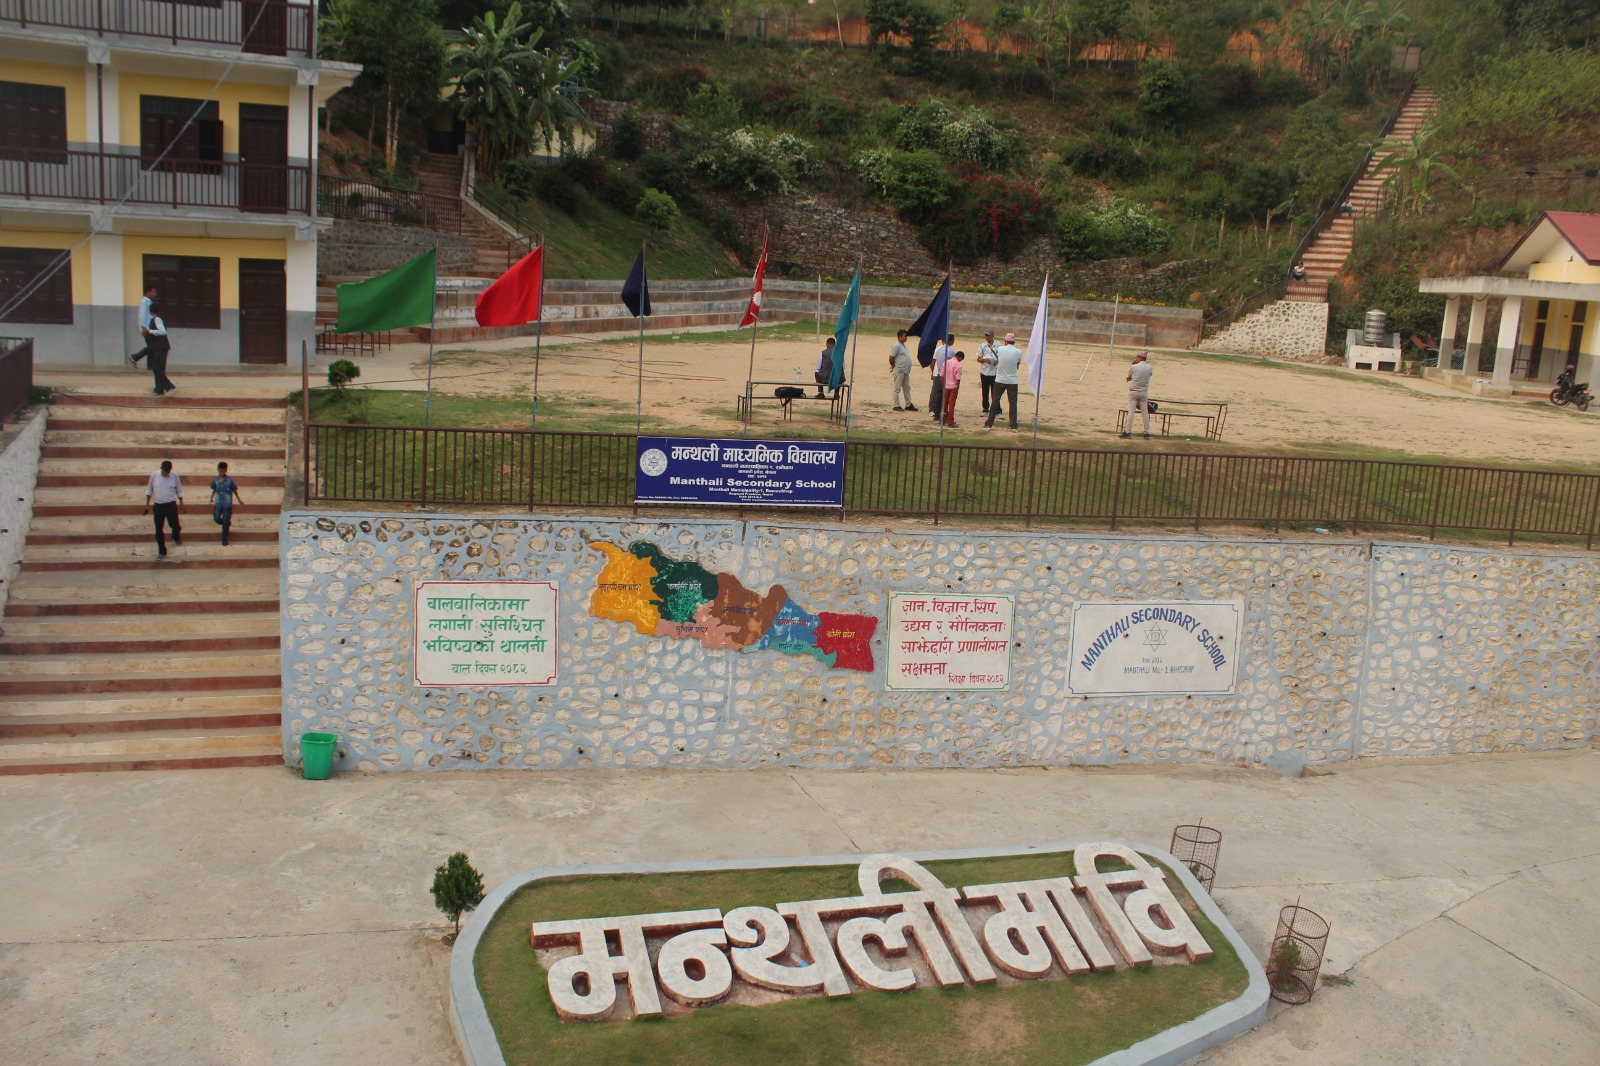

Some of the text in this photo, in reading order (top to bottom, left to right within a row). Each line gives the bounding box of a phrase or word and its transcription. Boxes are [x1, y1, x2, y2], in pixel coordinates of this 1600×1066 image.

[672, 443, 837, 464] मन्थली माध्यमिक विद्यालय
[670, 476, 836, 490] Manthali Secondary School
[426, 593, 530, 612] बालबालिकामा
[429, 614, 473, 632] लगानी
[901, 621, 932, 632] उद्यम
[937, 621, 944, 633] र
[424, 635, 548, 653] भविष्यको थालनी
[1081, 608, 1226, 671] MANTHALI SECONDARY SCHOOL
[451, 663, 472, 675] बाल
[474, 661, 497, 675] दिवस
[901, 662, 947, 678] सक्षमता
